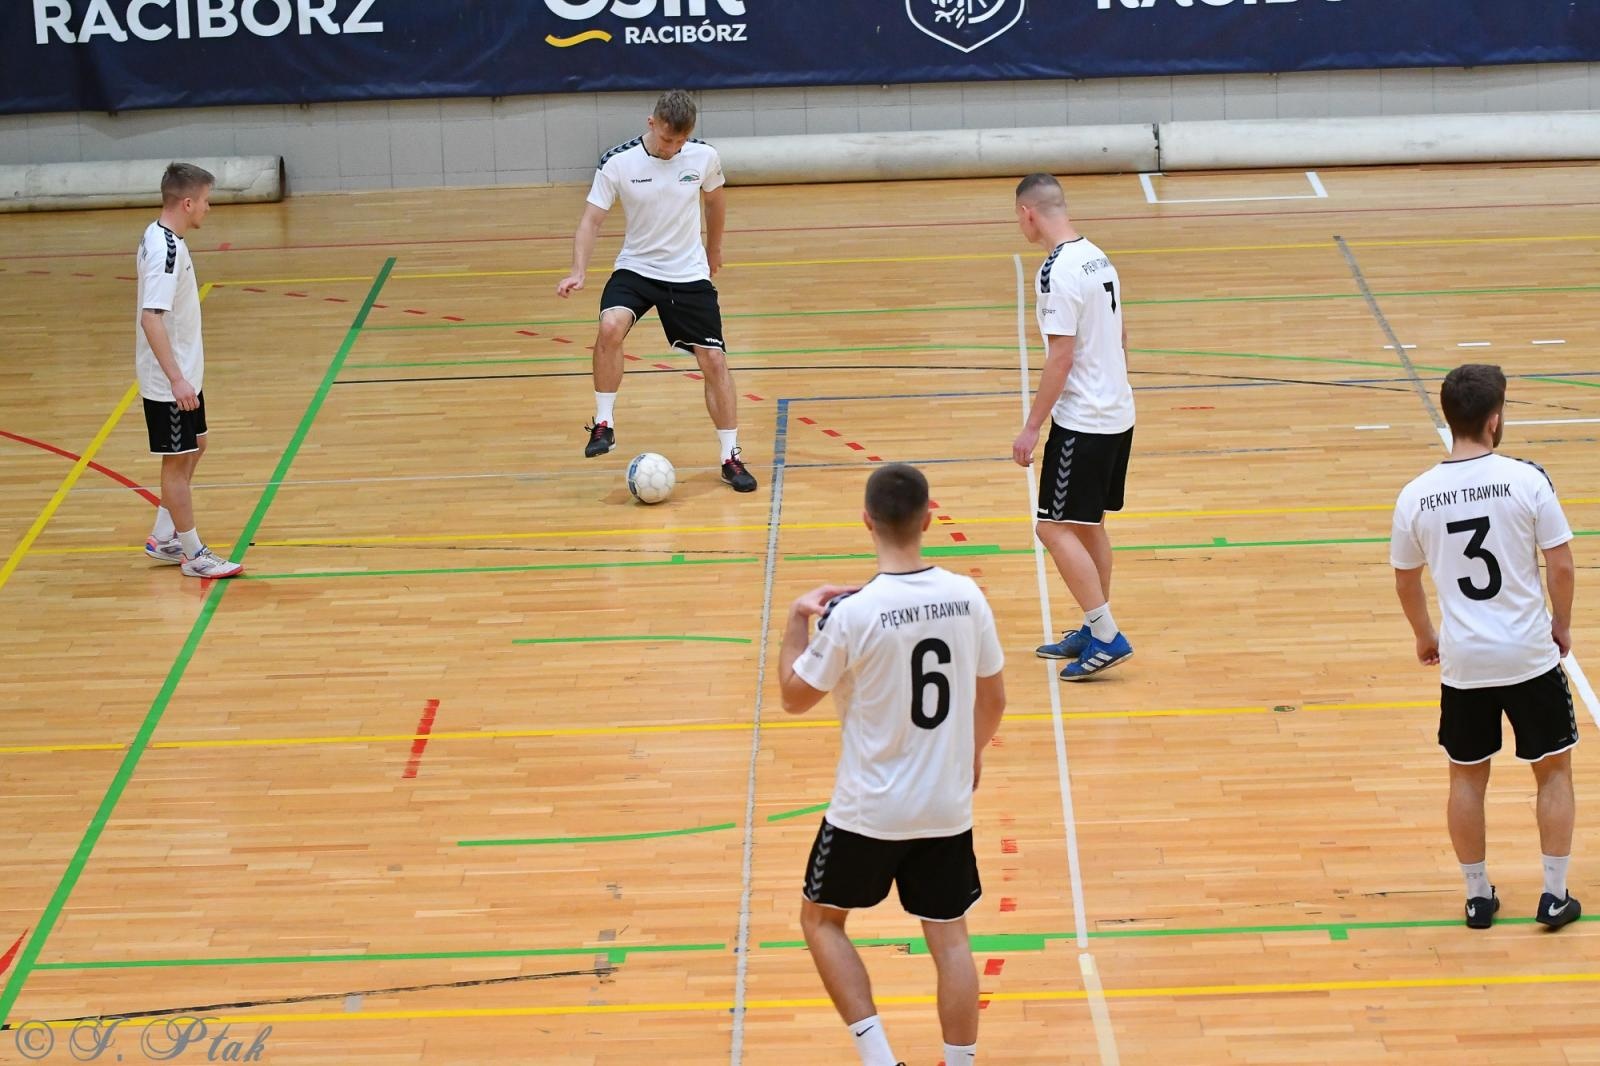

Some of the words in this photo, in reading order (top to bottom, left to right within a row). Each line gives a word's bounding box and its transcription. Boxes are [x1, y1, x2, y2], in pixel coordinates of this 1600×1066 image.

[625, 19, 748, 45] RACIBÓRZ
[1420, 492, 1458, 511] PIĘKNY
[1461, 484, 1511, 503] TRAWNIK
[1446, 515, 1503, 601] 3
[880, 605, 921, 630] PIĘKNY
[923, 600, 971, 620] TRAWNIK
[910, 637, 952, 730] 6
